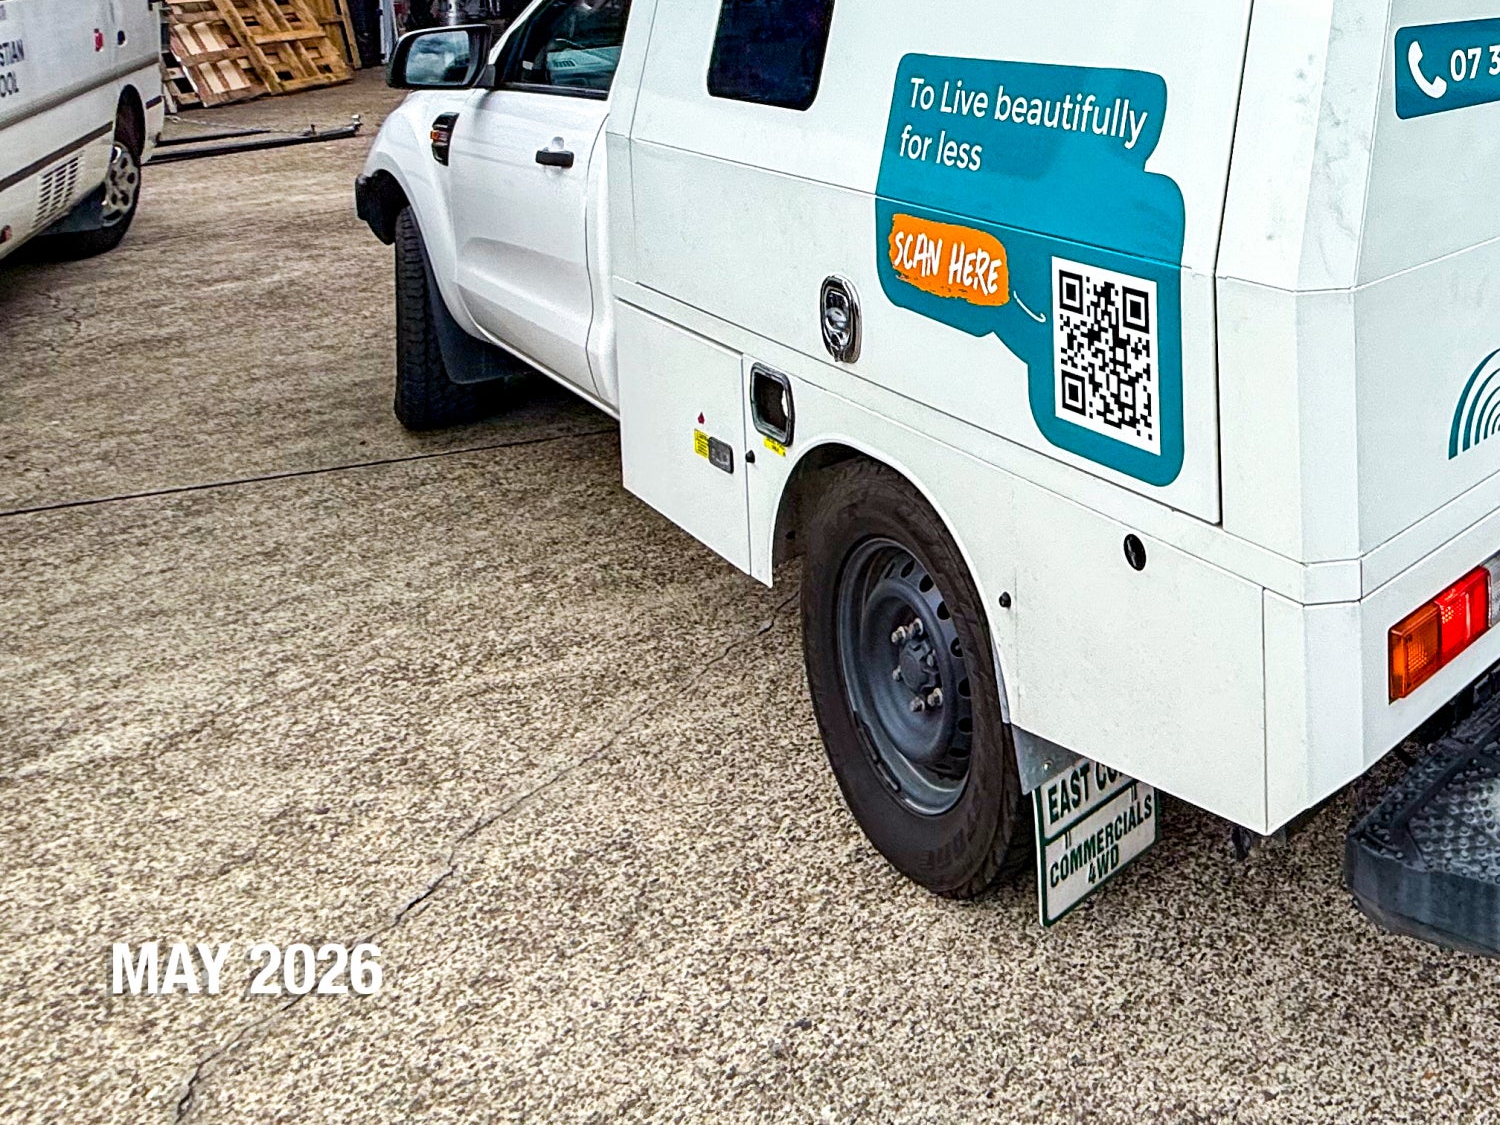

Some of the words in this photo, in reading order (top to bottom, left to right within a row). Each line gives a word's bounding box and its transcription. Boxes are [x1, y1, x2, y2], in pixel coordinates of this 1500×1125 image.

[1450, 49, 1480, 82] 07
[910, 77, 935, 111] To
[940, 79, 988, 119] Live
[994, 86, 1148, 150] beautifully
[899, 124, 931, 161] for
[936, 131, 982, 172] less
[892, 230, 942, 279] SCAN
[948, 242, 1003, 297] HERE
[1047, 762, 1090, 825] EAST
[1049, 794, 1152, 888] COMMERCIALS
[1088, 844, 1119, 884] 4WD
